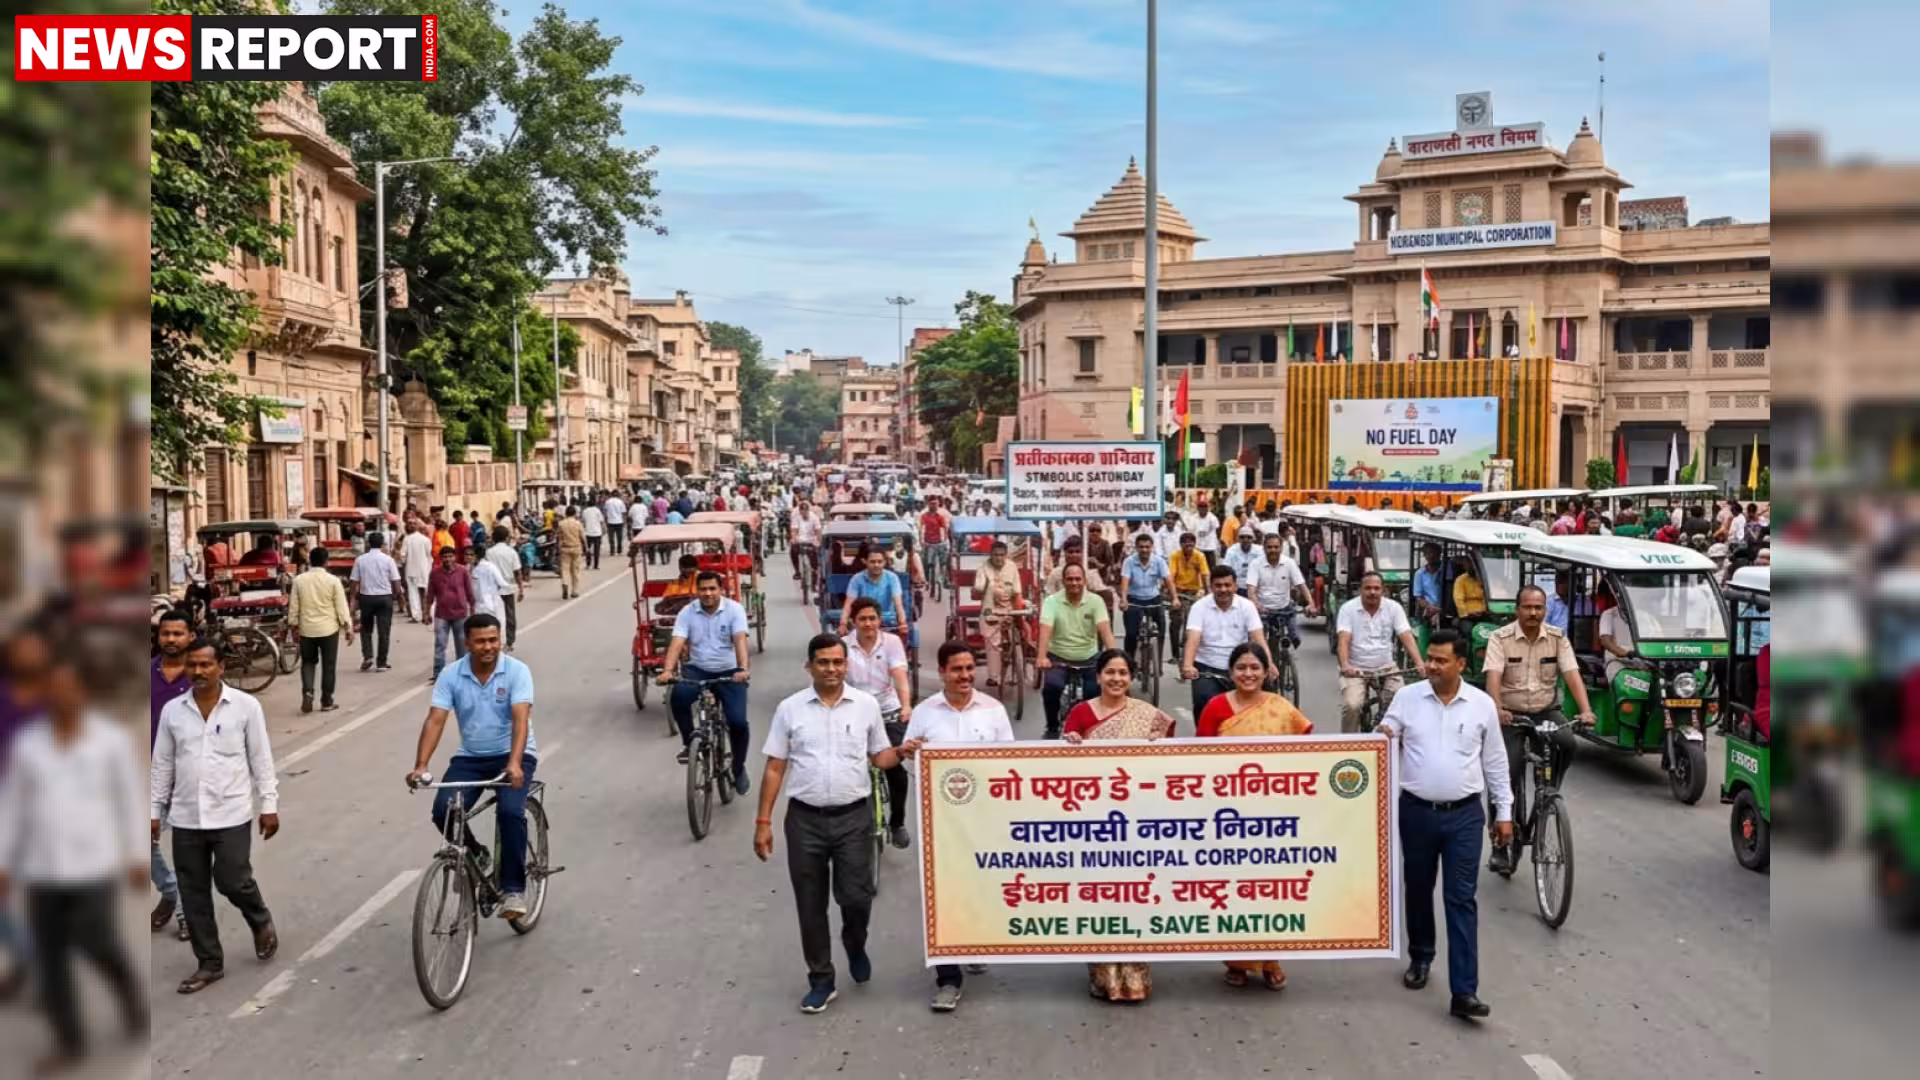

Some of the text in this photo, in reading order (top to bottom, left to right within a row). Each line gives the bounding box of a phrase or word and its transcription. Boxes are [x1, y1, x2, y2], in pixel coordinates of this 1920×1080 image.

[1485, 225, 1552, 243] CORPORATION
[1366, 427, 1457, 445] NO FUEL DAY
[988, 768, 1023, 801] नो
[1031, 776, 1102, 811] फ्यूल
[1109, 767, 1131, 801] डे
[1165, 774, 1206, 801] हर
[1212, 763, 1319, 797] शनिवार
[1010, 807, 1300, 843] वाराणसी नगर निगम
[975, 846, 1337, 869] VARANASI MUNICIPAL CORPORATION
[1077, 872, 1161, 905] बचाएं,
[1171, 880, 1231, 910] राष्ट्र
[1236, 869, 1314, 902] बचाएं
[1008, 913, 1305, 938] SAVE FUEL, SAVE NATION
